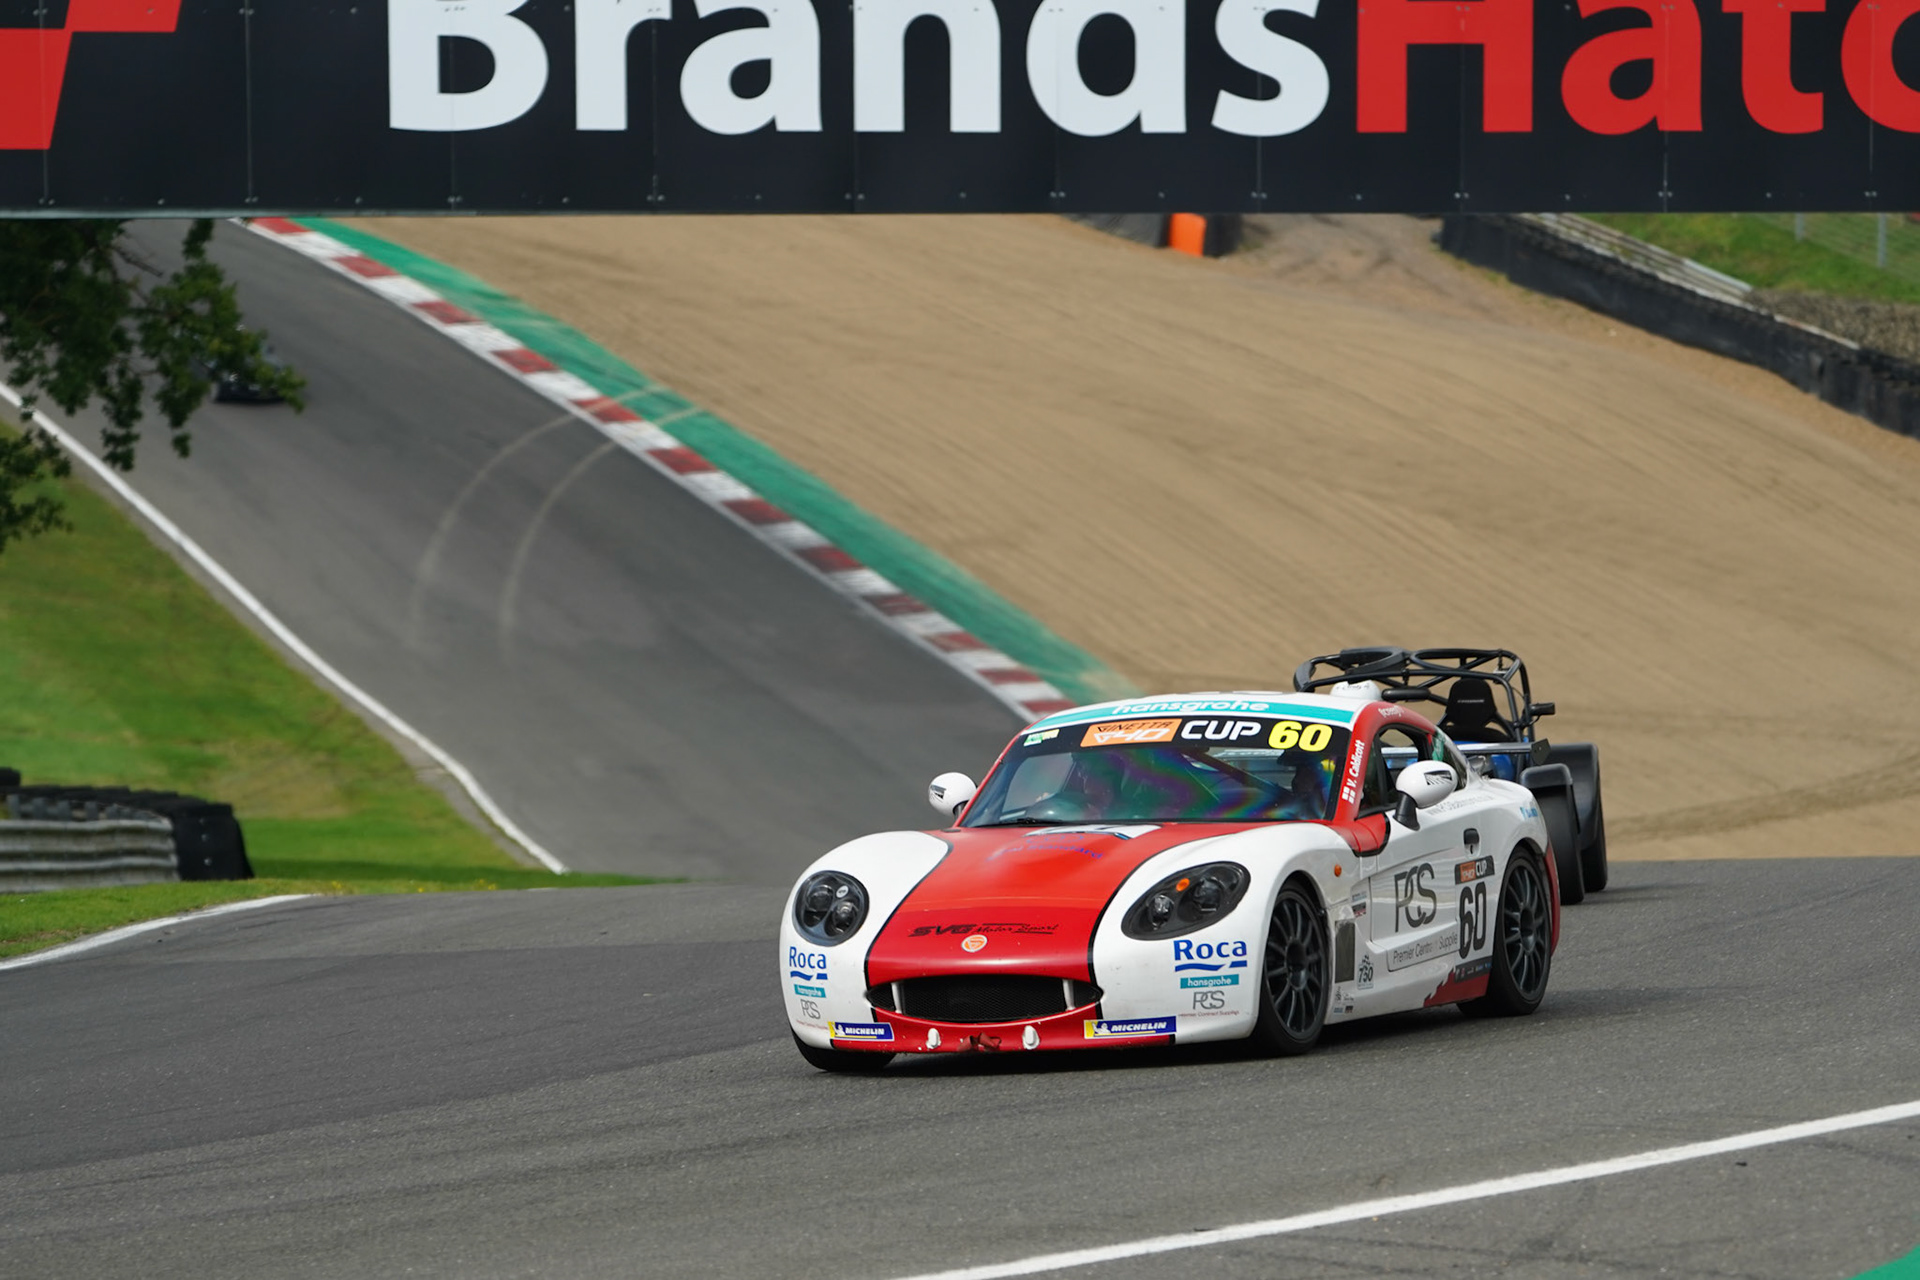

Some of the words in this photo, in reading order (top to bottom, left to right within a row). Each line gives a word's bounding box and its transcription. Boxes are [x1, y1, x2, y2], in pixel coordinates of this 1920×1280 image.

[1111, 700, 1270, 715] hansgrohe
[1097, 720, 1173, 732] GINETTA
[1181, 719, 1262, 741] CUP
[1267, 720, 1333, 752] 60
[1346, 778, 1358, 788] V.
[1394, 862, 1437, 934] PCS
[908, 923, 978, 937] SVG
[1458, 881, 1487, 960] 60
[789, 946, 827, 970] Roca
[1173, 939, 1248, 961] Roca
[1187, 976, 1232, 988] hansgrohe
[800, 998, 821, 1020] PCS
[1193, 990, 1225, 1010] PCS
[845, 1027, 885, 1036] MICHELIN
[1110, 1021, 1167, 1032] MICHELIN
